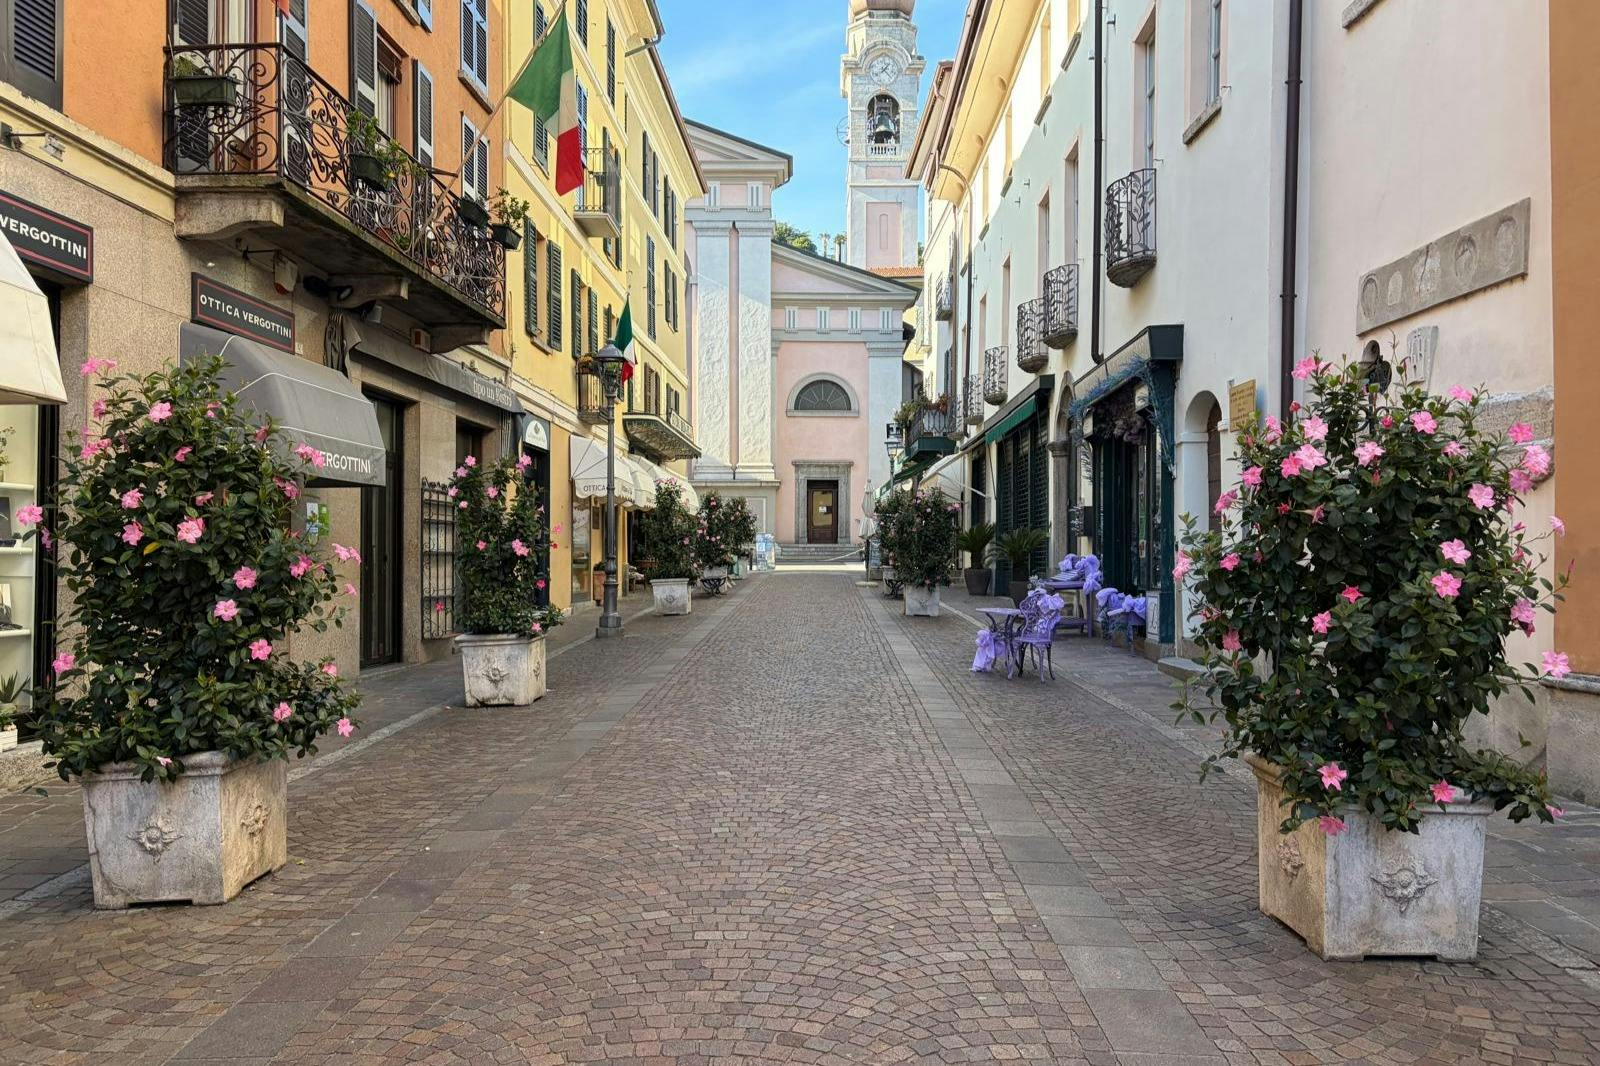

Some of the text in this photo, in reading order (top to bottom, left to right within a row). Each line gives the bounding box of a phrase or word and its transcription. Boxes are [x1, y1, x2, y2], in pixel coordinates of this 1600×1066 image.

[0, 214, 87, 259] VERGOTTINI
[200, 294, 292, 339] OTTICA VERGOTTINI
[583, 484, 606, 493] OTTICA
